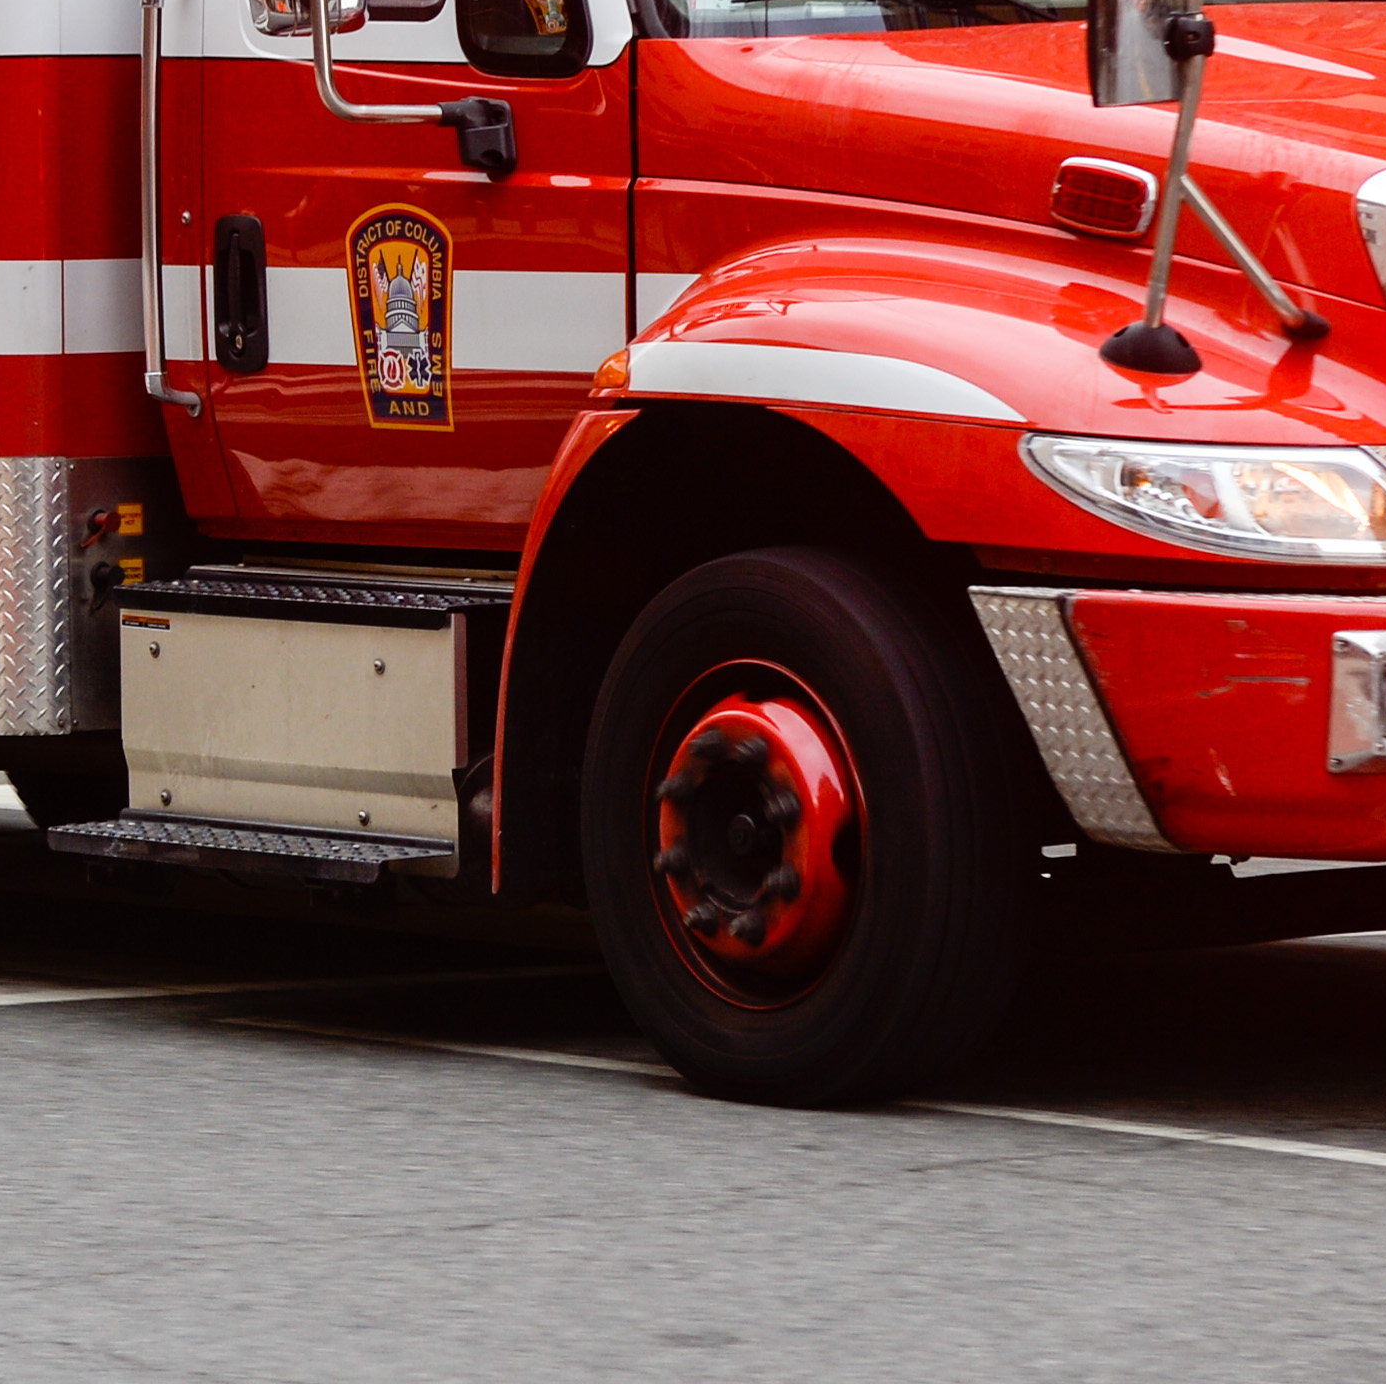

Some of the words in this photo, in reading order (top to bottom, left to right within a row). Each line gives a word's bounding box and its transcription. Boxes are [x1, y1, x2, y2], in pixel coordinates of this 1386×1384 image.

[356, 222, 383, 298] DISTRICT
[385, 220, 402, 236] OF
[404, 221, 443, 300] COLUMBIA
[363, 329, 382, 393] FIRE
[431, 332, 443, 397] EMS
[389, 401, 430, 416] AND
